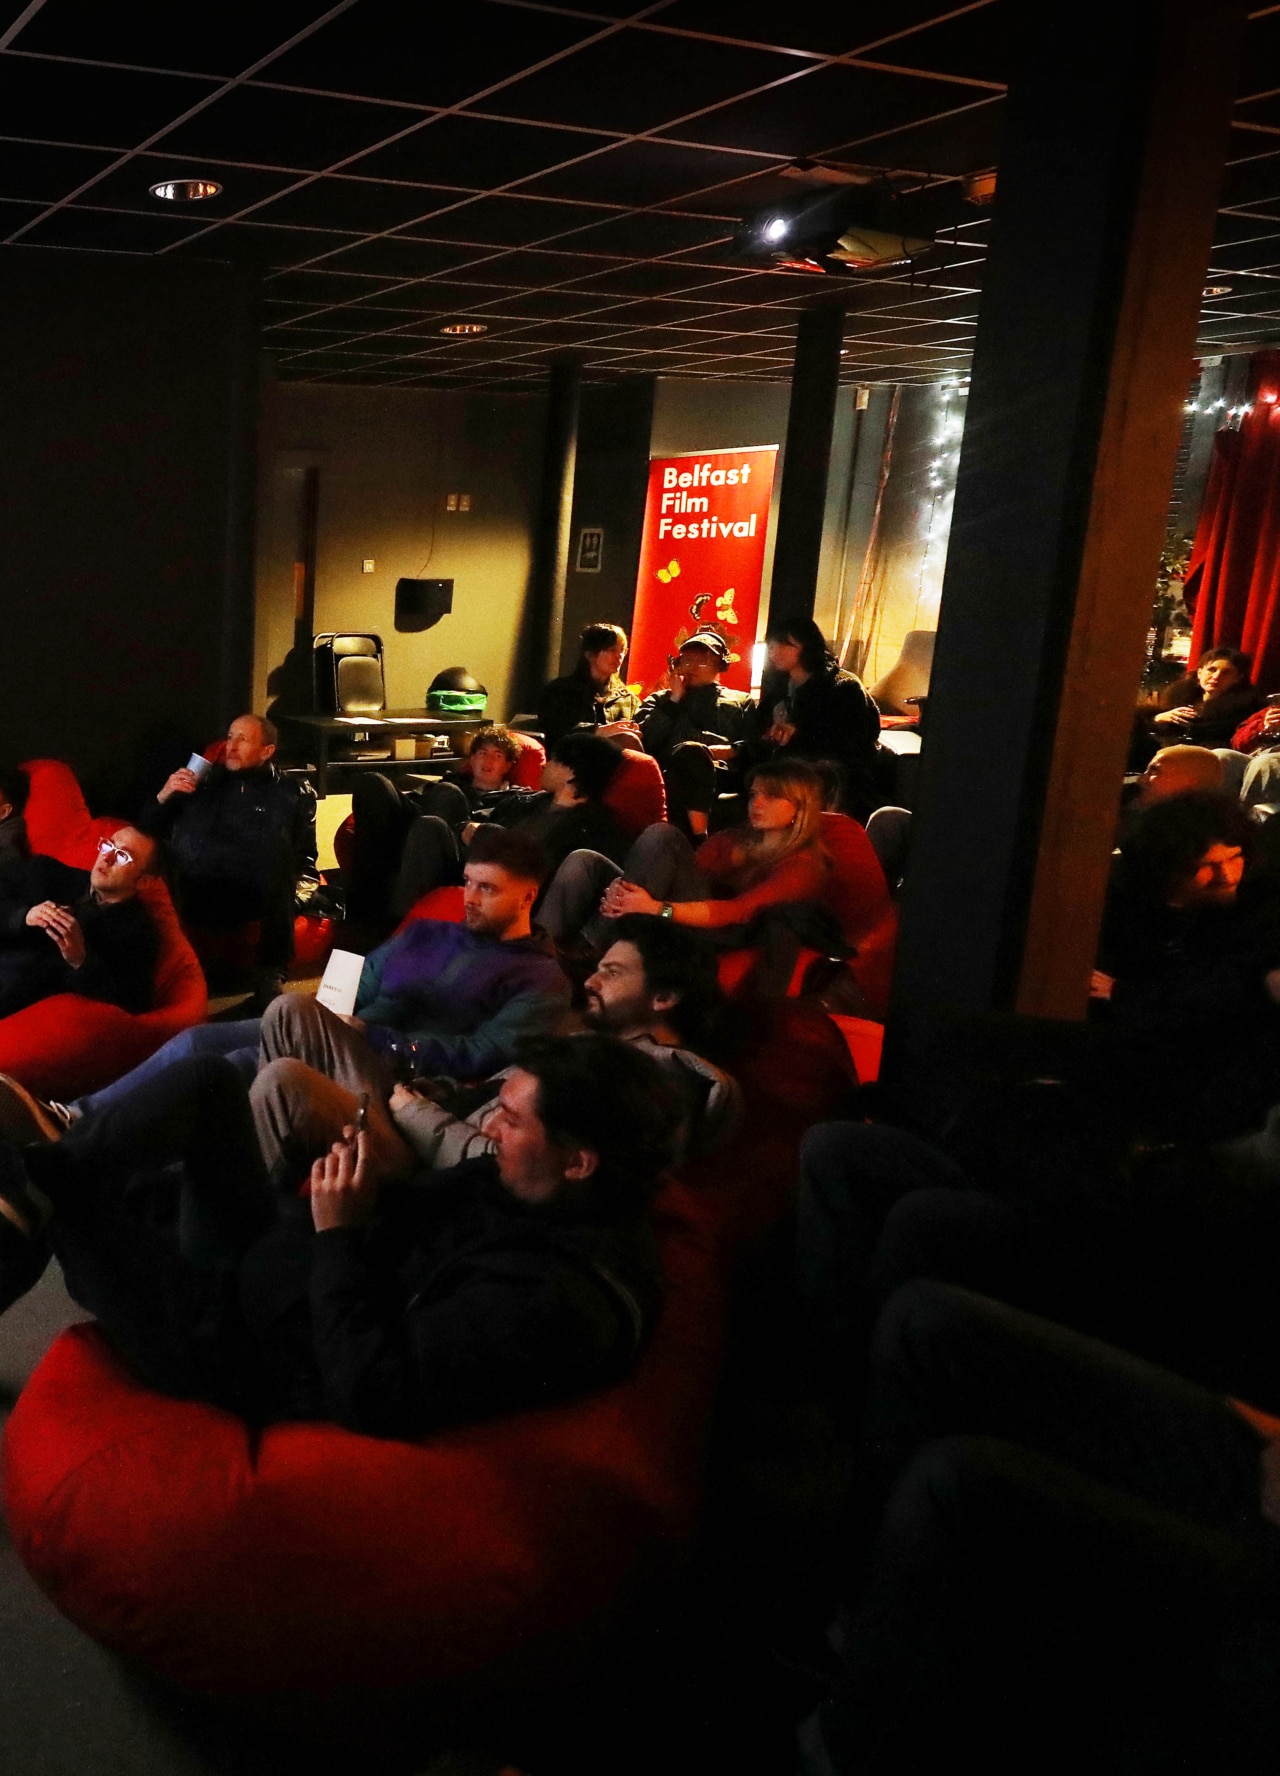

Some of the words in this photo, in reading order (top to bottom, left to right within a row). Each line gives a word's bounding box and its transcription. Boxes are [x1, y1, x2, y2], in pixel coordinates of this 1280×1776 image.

[663, 463, 751, 489] Belfast
[661, 490, 709, 514] Film
[658, 513, 757, 539] Festival
